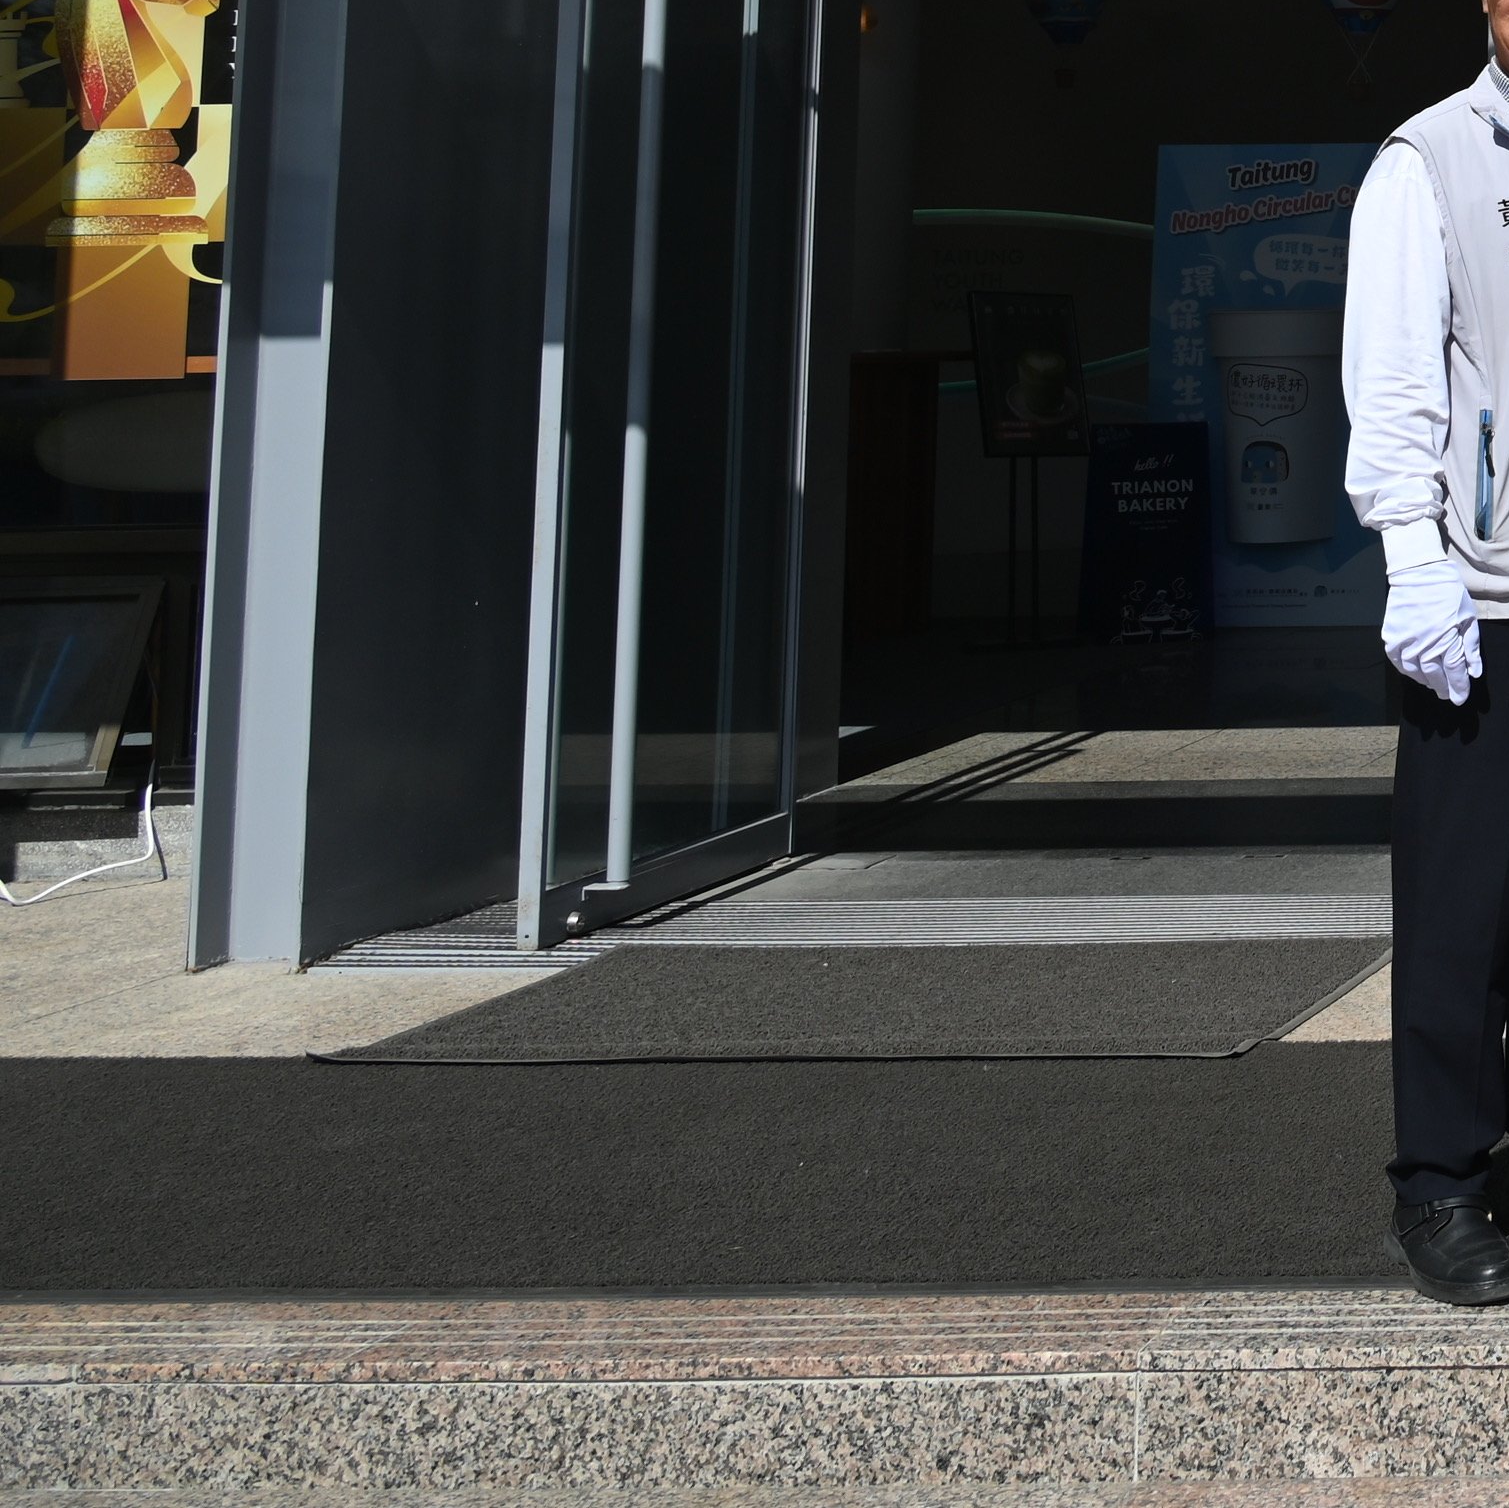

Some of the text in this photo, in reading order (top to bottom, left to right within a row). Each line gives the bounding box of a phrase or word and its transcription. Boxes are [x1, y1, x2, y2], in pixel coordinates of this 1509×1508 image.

[1227, 160, 1313, 188] Taitung
[1172, 185, 1358, 231] Nongho Circular Cu
[1111, 478, 1194, 495] TRIANON
[1118, 496, 1189, 513] BAKERY
